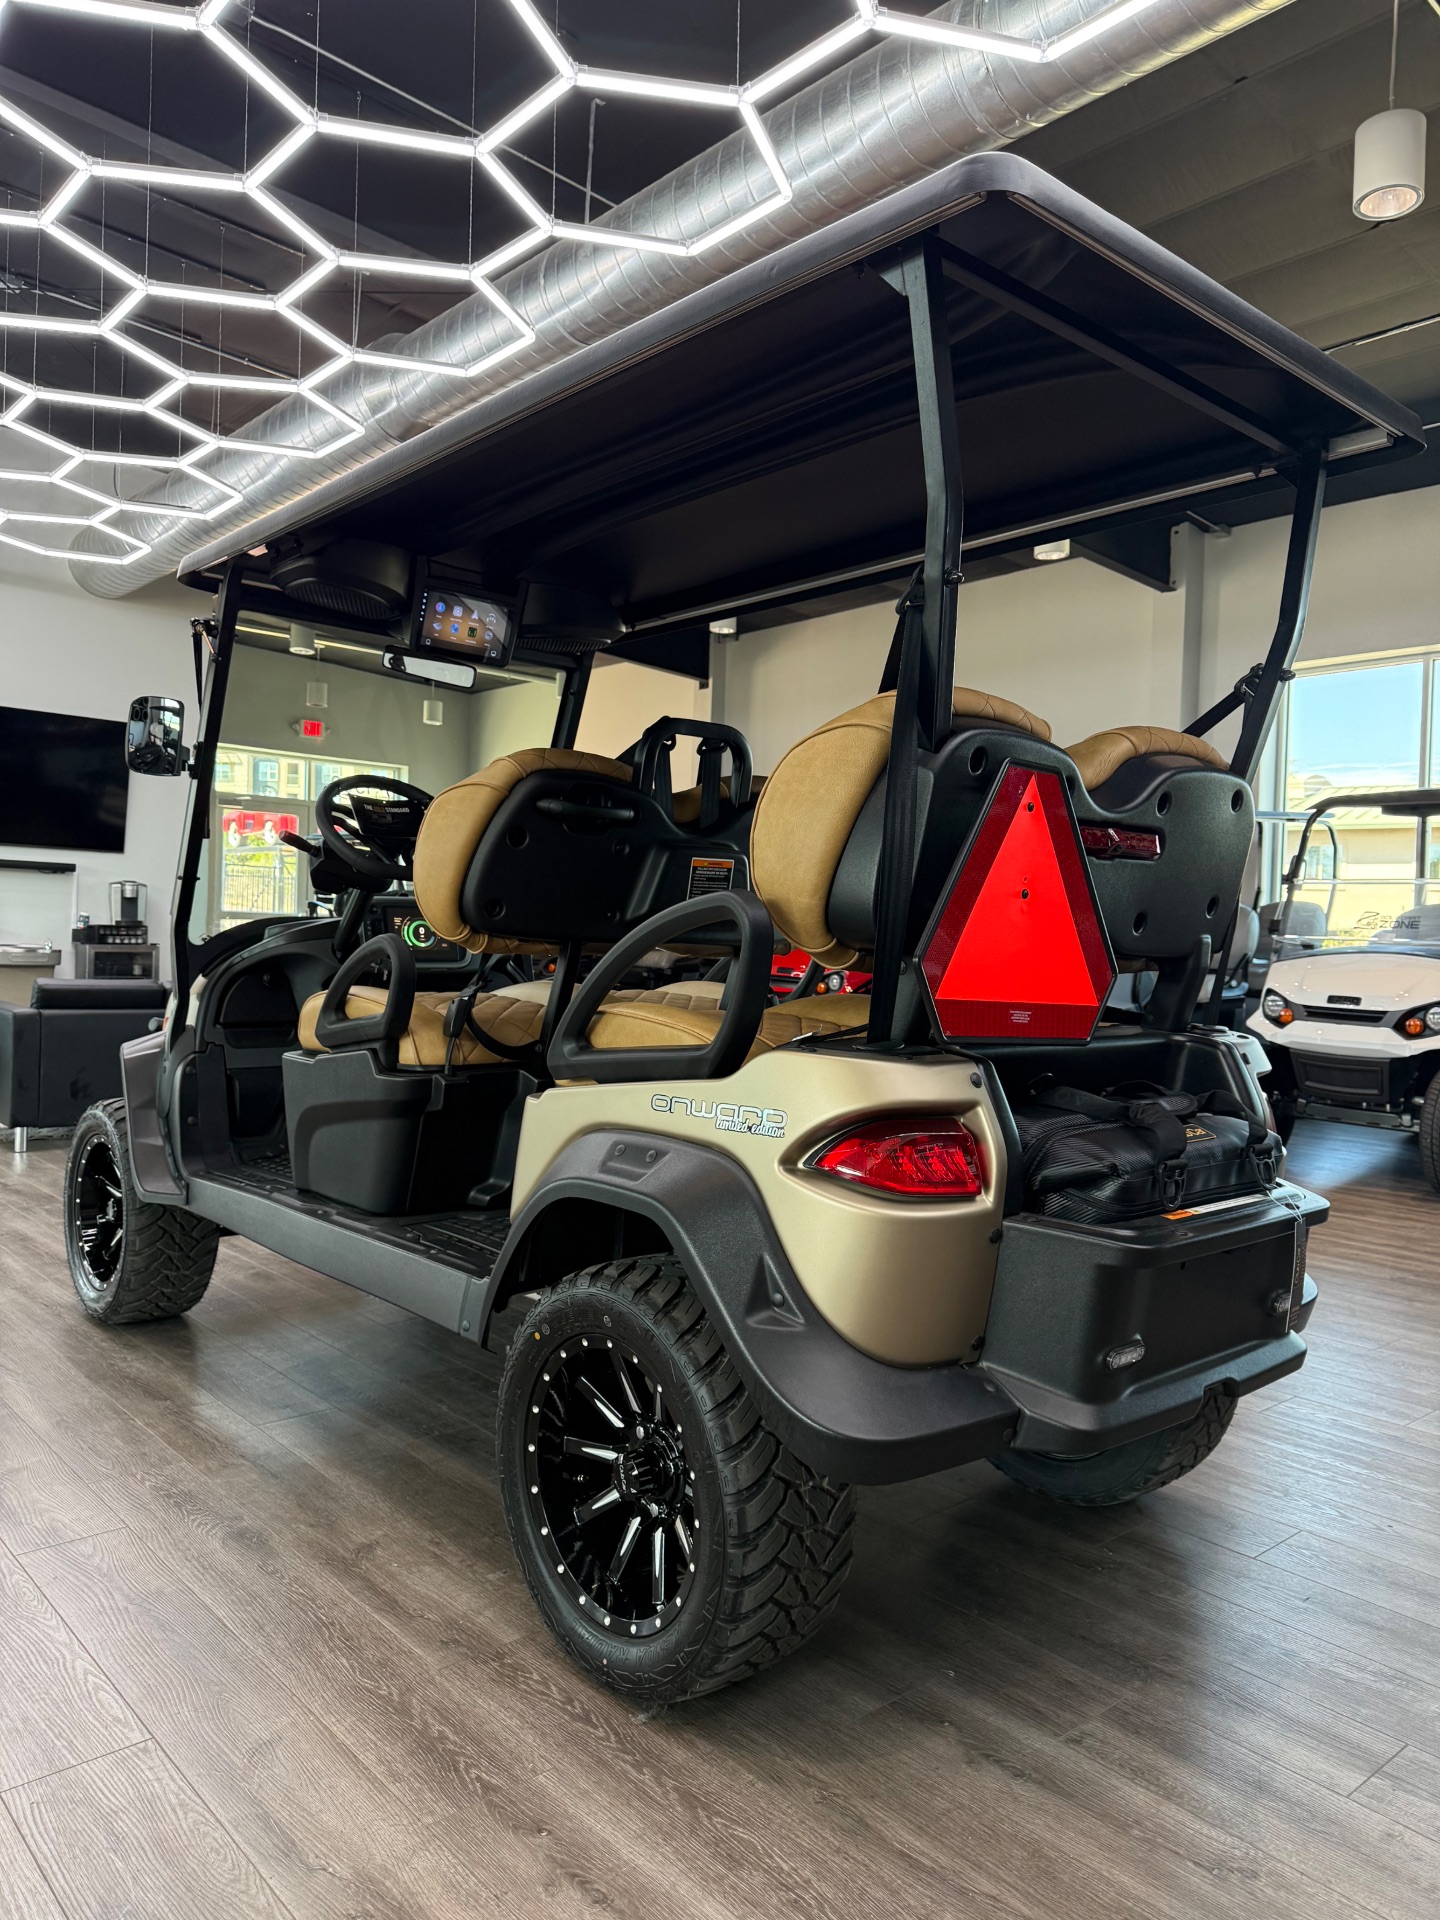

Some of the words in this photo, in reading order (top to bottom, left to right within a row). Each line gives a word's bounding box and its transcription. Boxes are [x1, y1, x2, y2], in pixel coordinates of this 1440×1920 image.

[1379, 920, 1422, 930] ZONE
[715, 1115, 750, 1133] limited
[751, 1120, 786, 1139] edition
